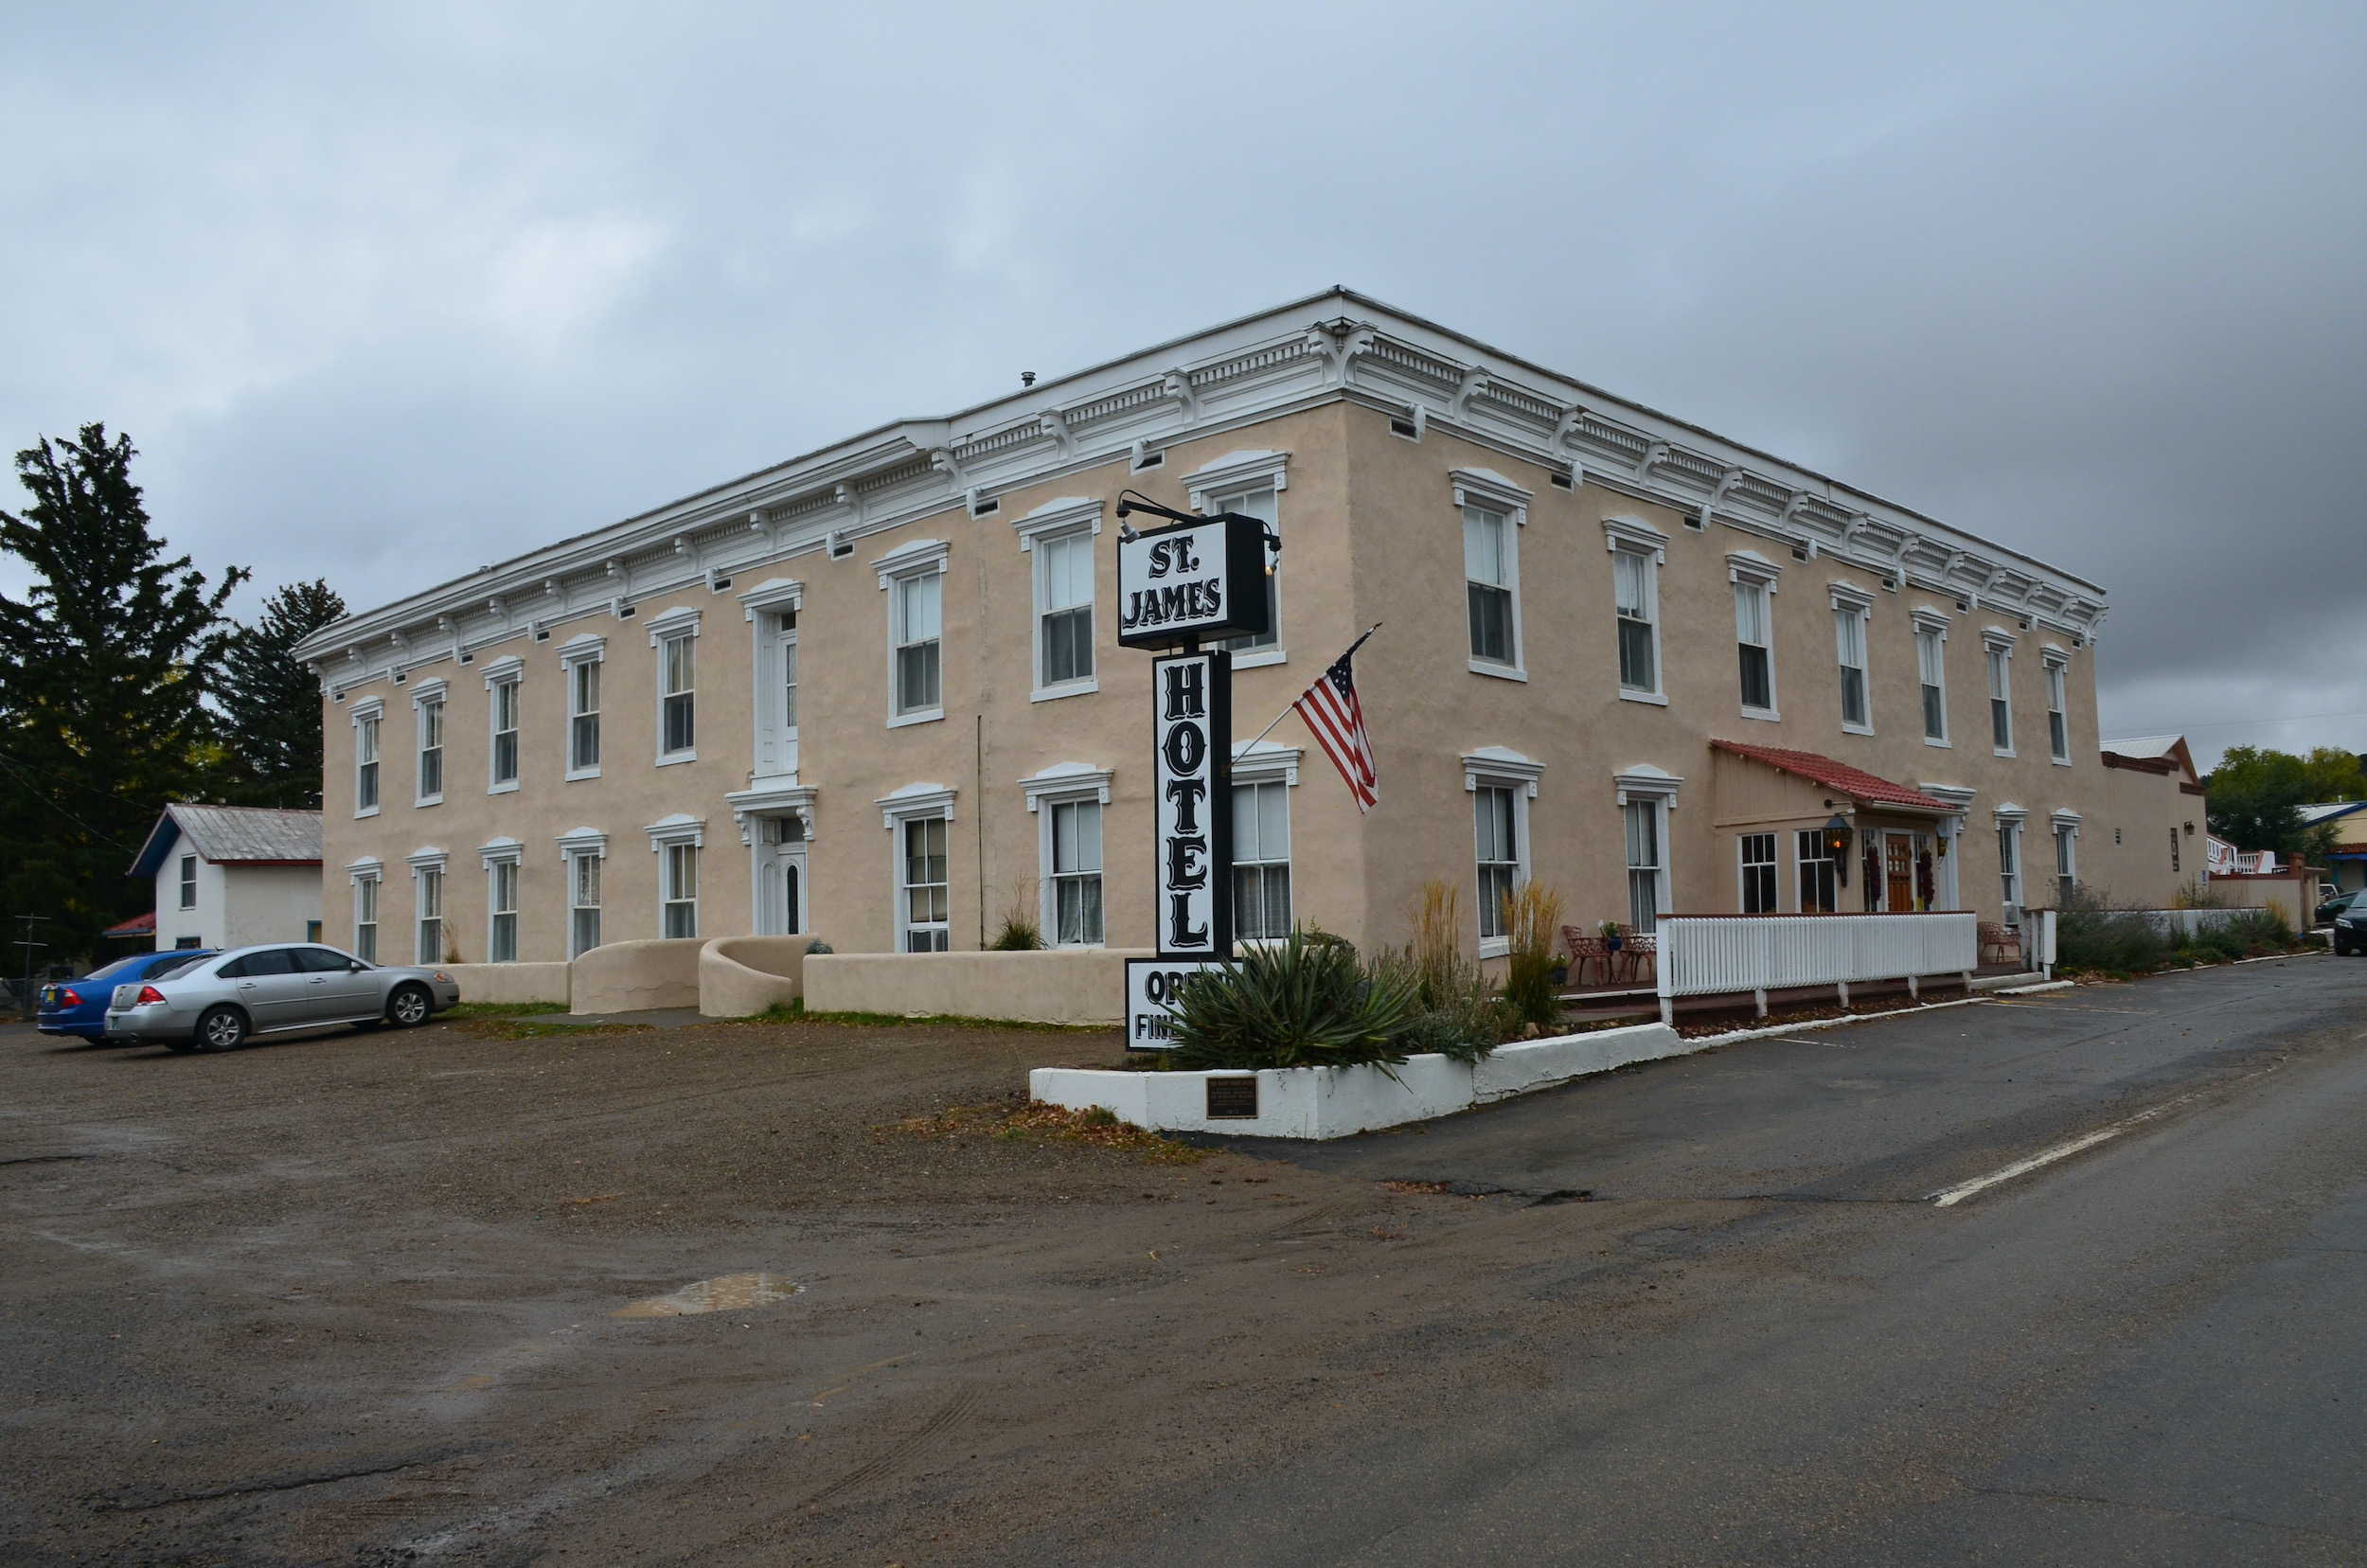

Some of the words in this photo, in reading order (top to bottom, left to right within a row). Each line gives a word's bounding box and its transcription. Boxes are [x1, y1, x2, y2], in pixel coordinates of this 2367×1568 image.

[1148, 534, 1200, 579] ST.
[1122, 577, 1221, 629] JAMES
[1162, 662, 1209, 948] HOTEL
